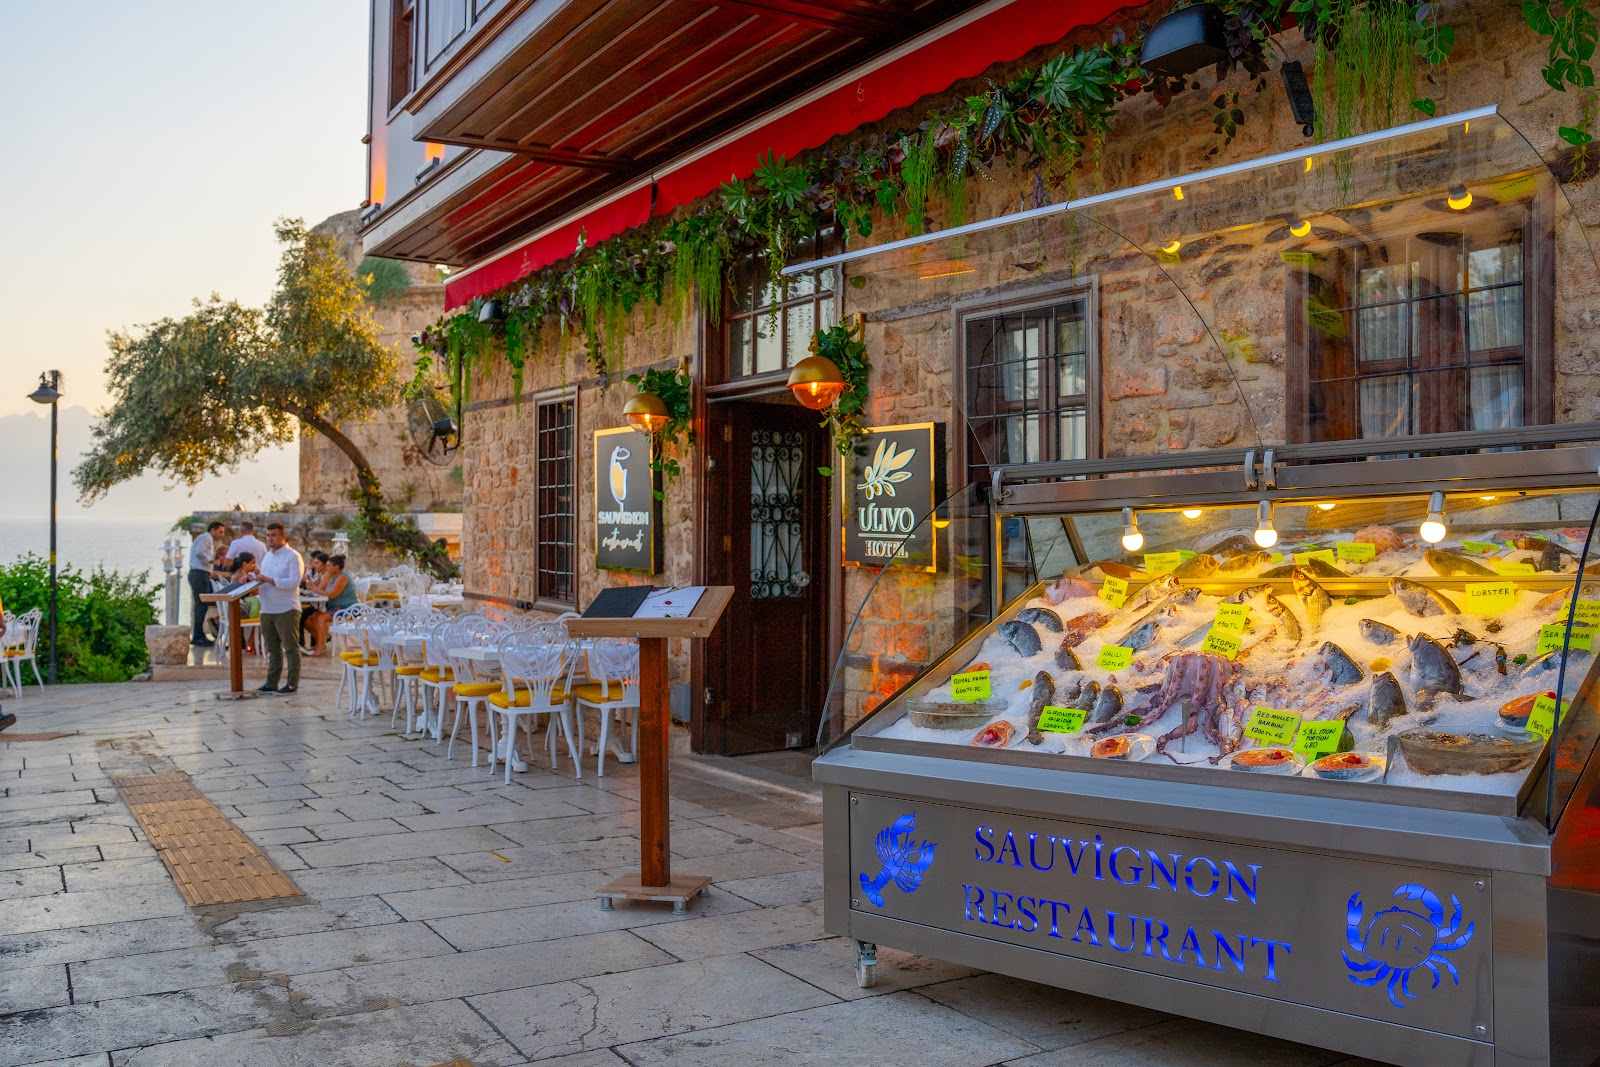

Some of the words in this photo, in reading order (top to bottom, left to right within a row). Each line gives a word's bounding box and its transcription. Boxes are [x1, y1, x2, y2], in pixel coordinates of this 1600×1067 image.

[598, 511, 649, 525] SAUVIGNON
[865, 540, 909, 558] HOTEL
[1471, 587, 1510, 597] LOBSTER
[1543, 630, 1559, 638] SEA
[1207, 634, 1237, 651] OCTOPUS
[1209, 642, 1229, 654] PORTION
[953, 677, 971, 685] ROYAL
[1046, 709, 1083, 719] GROUPER
[1271, 714, 1296, 722] MULLET
[1258, 719, 1284, 729] BARBUN
[1302, 727, 1337, 736] SALMON
[1303, 741, 1319, 750] 480
[961, 884, 1292, 983] RESTAURANT
